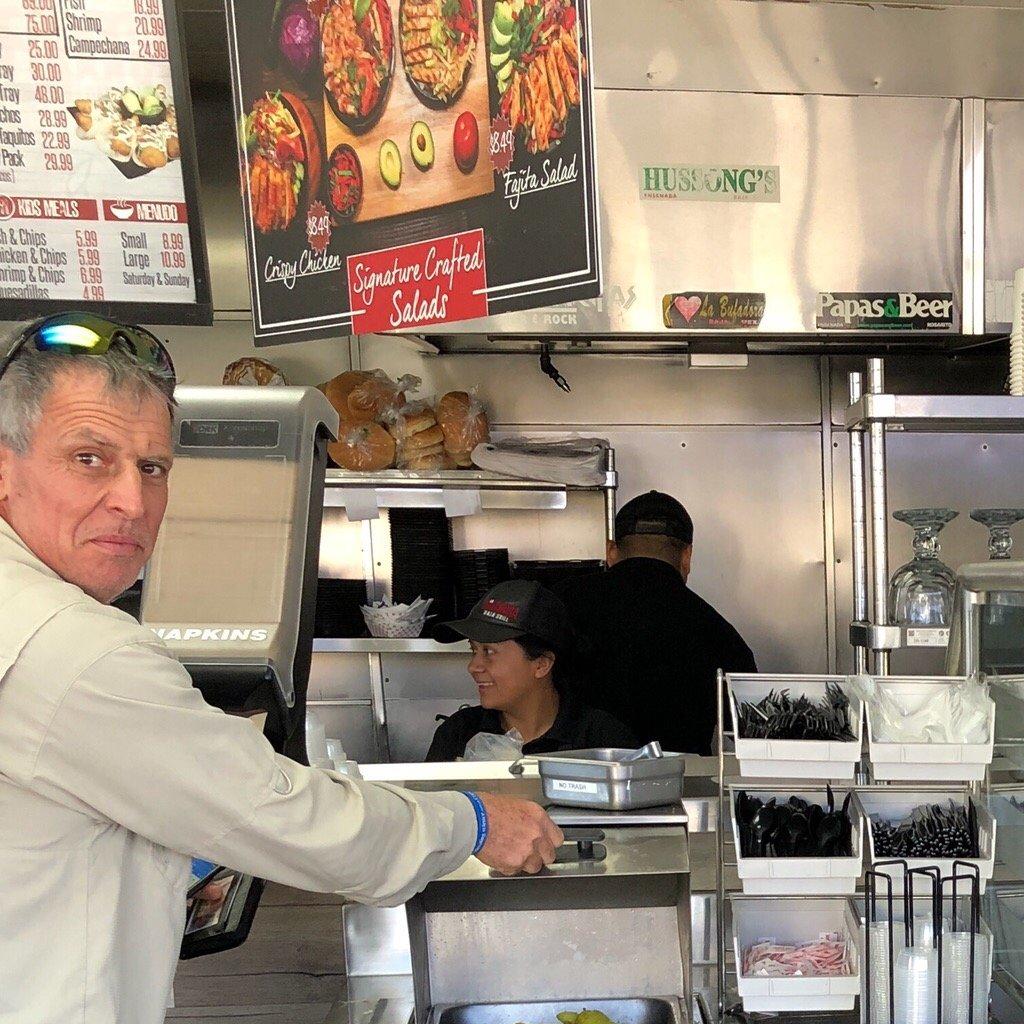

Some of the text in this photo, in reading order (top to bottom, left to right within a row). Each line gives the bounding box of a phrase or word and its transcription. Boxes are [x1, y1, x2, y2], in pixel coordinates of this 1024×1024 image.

[66, 12, 165, 36] Shrimp 20.99
[28, 40, 59, 59] 25.00
[69, 35, 167, 59] Campechana 24.99
[0, 63, 62, 82] ray 30.00
[35, 85, 65, 104] 48.00
[39, 110, 68, 128] 28.99
[42, 131, 71, 149] 22.99
[2, 149, 74, 171] Pack 29.99
[503, 153, 578, 210] Fajita Salad
[643, 167, 777, 194] HUSSONG'S
[17, 199, 41, 217] KIDS
[43, 200, 80, 218] MEALS
[136, 203, 178, 222] MENUDO
[9, 228, 18, 246] &
[19, 228, 47, 248] Chips
[75, 230, 98, 247] 5.99
[120, 231, 184, 250] Small 8.99
[30, 247, 38, 264] &
[40, 248, 67, 267] Chips
[78, 249, 100, 266] 5.99
[123, 250, 186, 270] Large 10.99
[0, 265, 102, 285] hrimp & Chips 6.99
[123, 271, 189, 288] Saturday & Sunday
[264, 250, 342, 290] Crispy Chicken
[354, 237, 483, 306] Signature Crafted
[0, 284, 105, 300] uesadillas 4.99
[390, 285, 449, 327] Salads
[559, 782, 567, 790] NO
